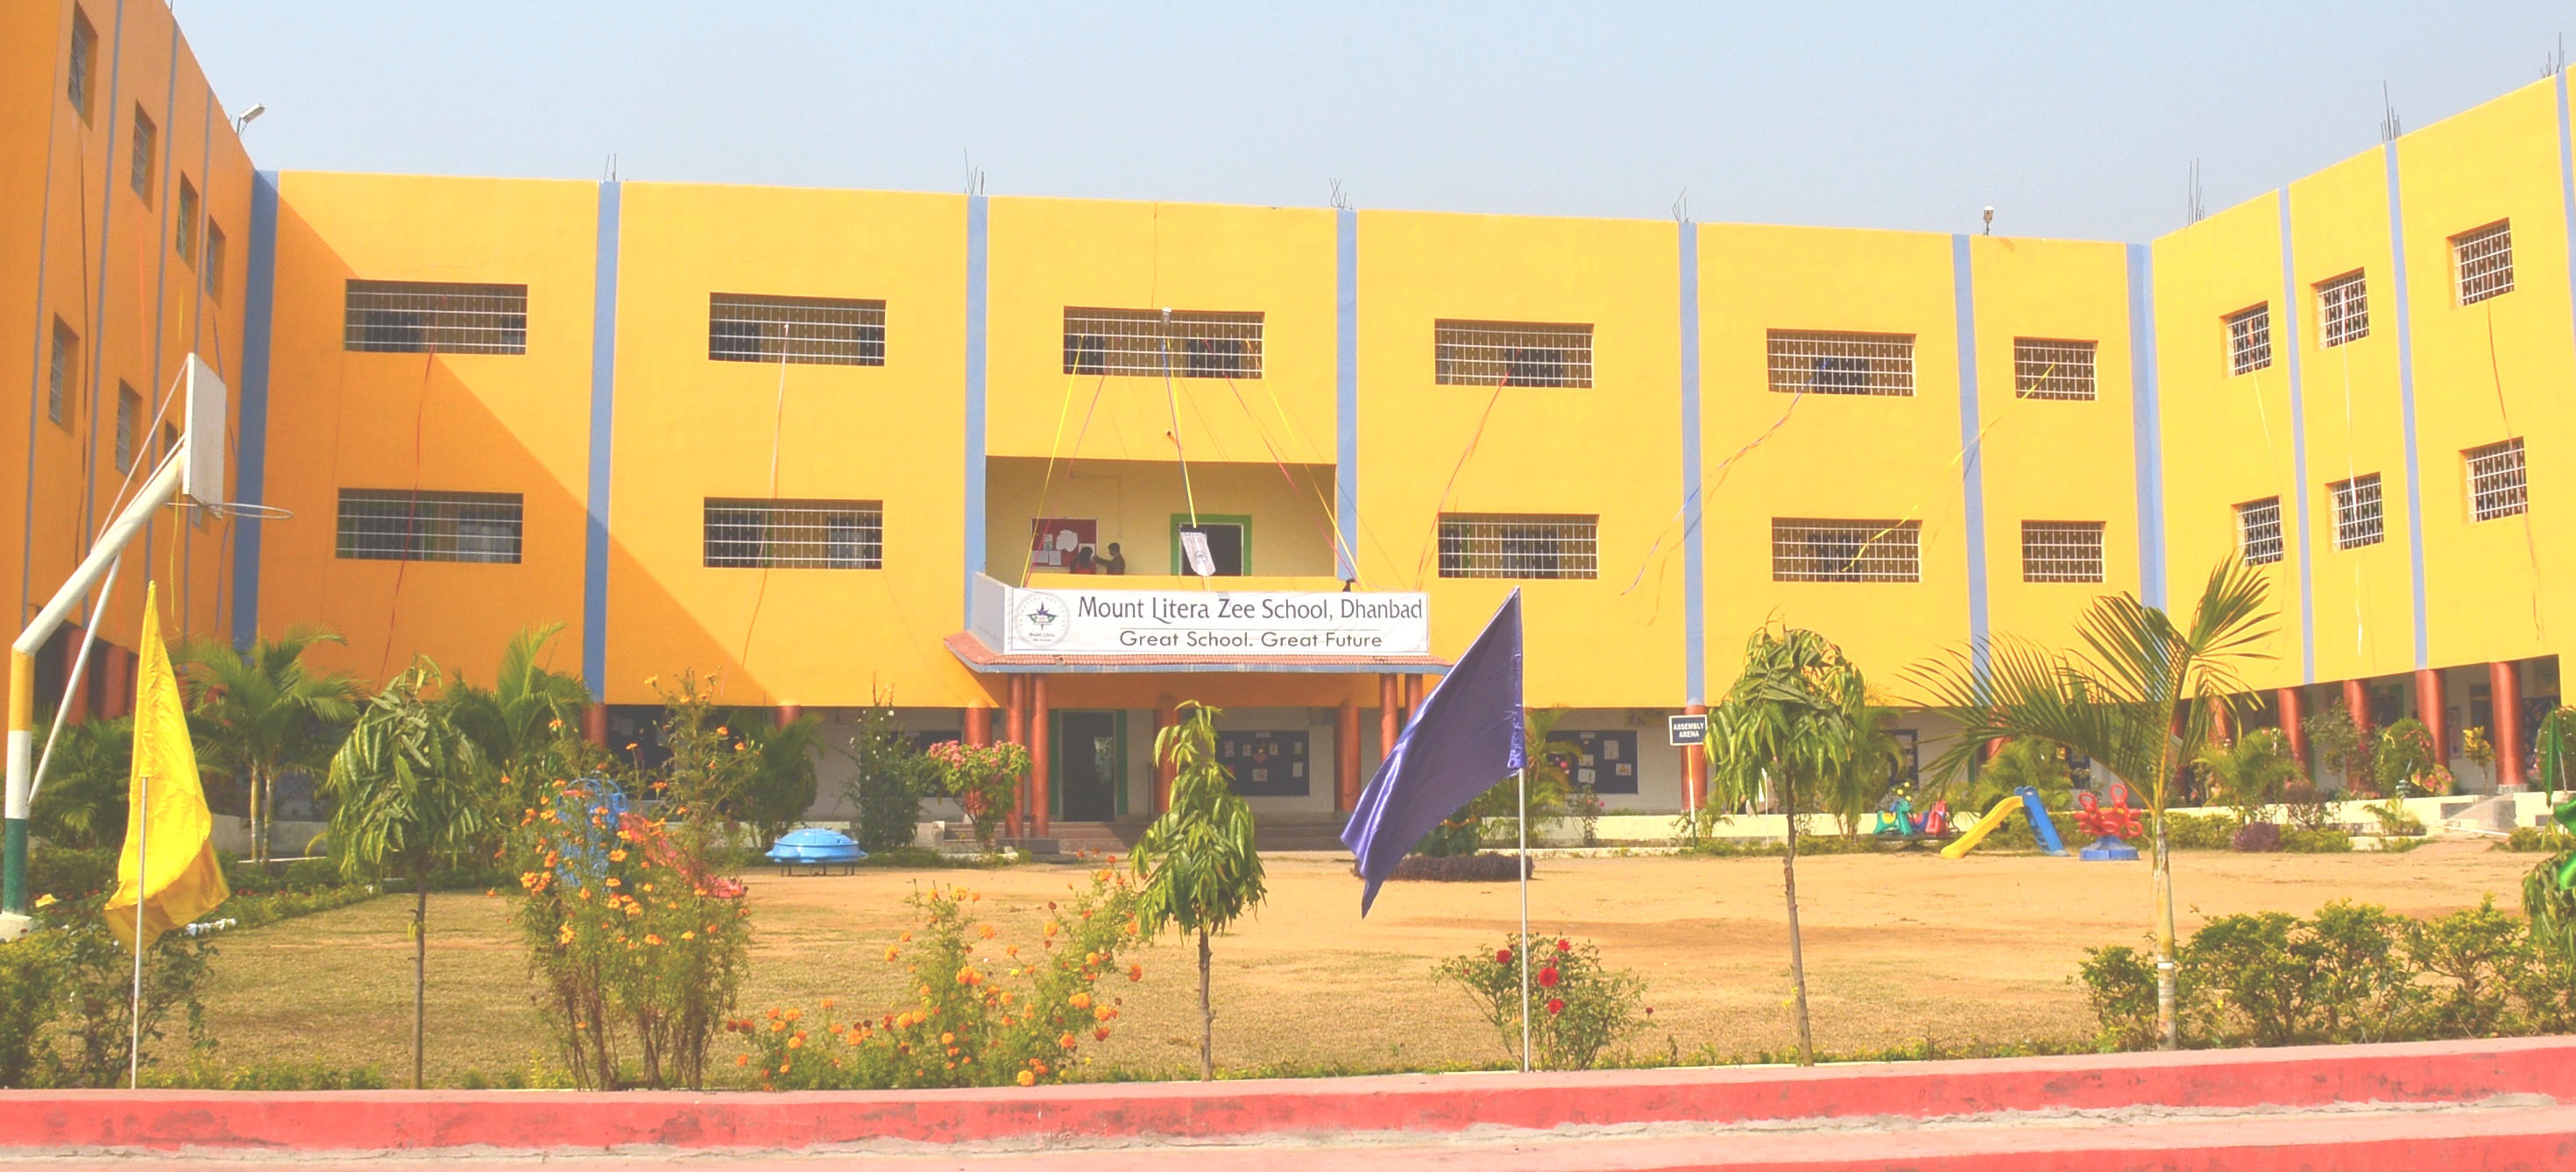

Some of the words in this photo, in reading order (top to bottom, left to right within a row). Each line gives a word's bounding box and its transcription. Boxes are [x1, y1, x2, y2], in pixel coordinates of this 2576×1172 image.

[1078, 596, 1144, 618] Mount
[1152, 597, 1210, 625] Litera
[1217, 598, 1256, 619] Zee
[1262, 598, 1334, 621] School,
[1341, 598, 1423, 619] Dhanbad
[1120, 630, 1179, 646] Great
[1186, 631, 1254, 647] School.
[1261, 632, 1319, 647] Great
[1326, 632, 1383, 647] Future
